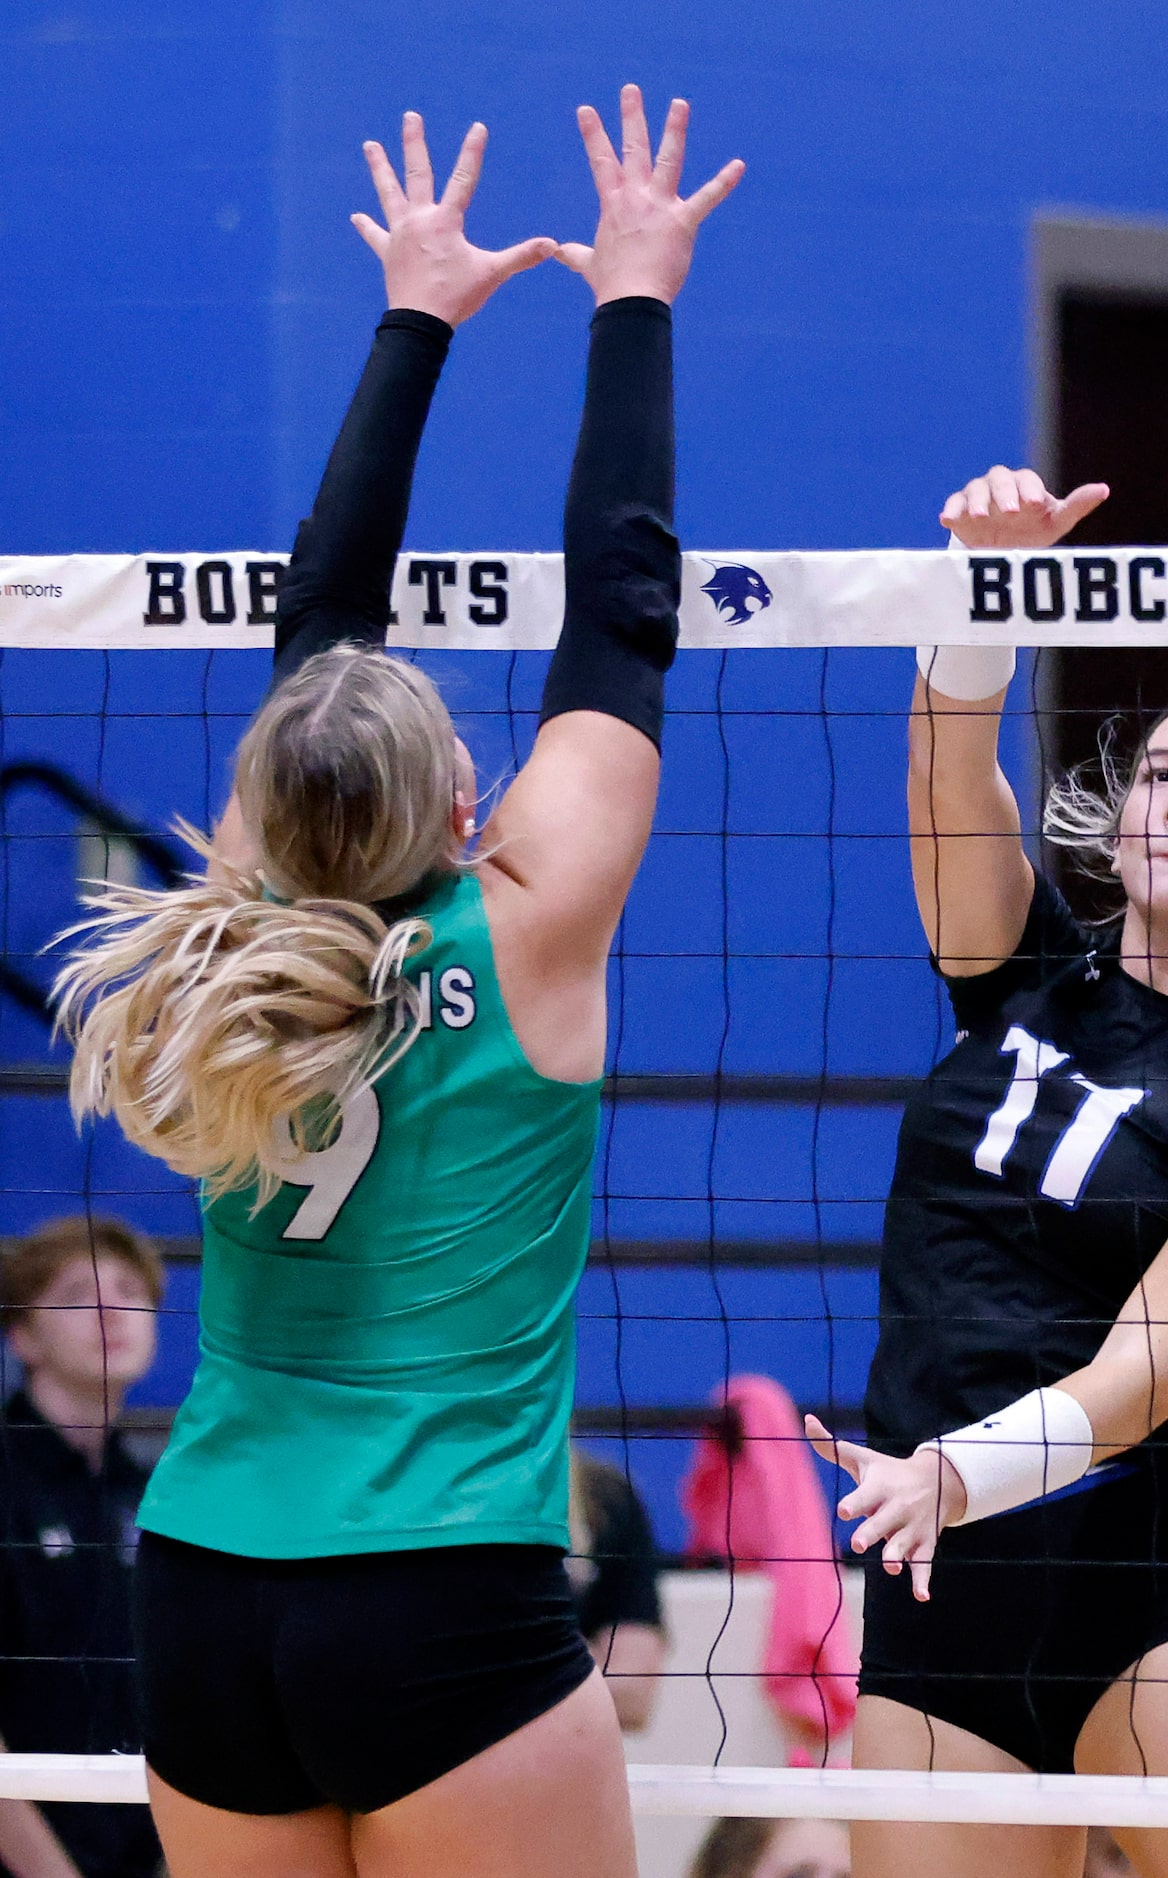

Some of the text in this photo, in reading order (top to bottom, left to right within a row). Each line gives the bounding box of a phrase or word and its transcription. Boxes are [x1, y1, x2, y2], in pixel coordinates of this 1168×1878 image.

[4, 584, 63, 598] imports
[143, 559, 510, 627] BOBTS
[266, 1083, 381, 1241] 9
